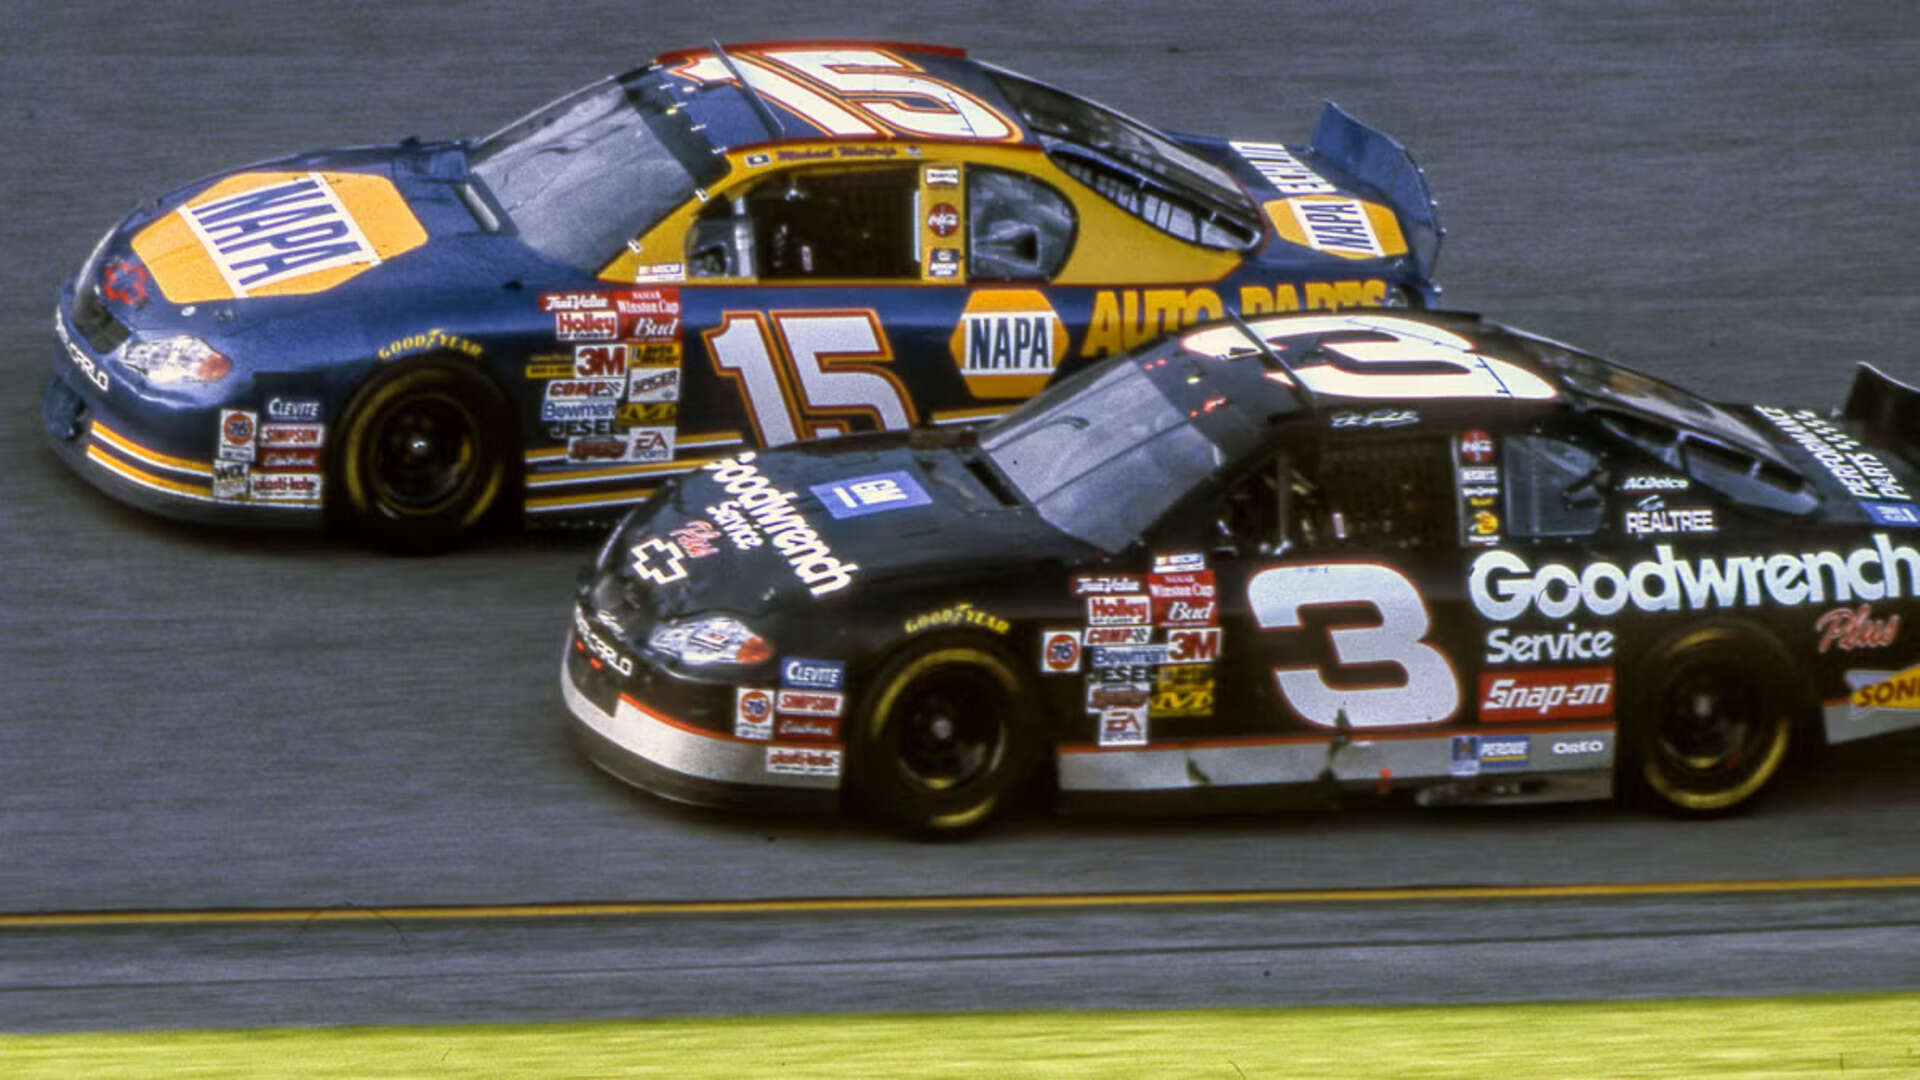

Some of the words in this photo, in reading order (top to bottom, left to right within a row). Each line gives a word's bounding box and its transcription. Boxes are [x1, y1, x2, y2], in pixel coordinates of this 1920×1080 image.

[667, 50, 1024, 141] 15
[190, 178, 363, 287] NAPA
[1300, 201, 1373, 250] NAPA
[617, 300, 657, 313] Winston
[658, 300, 679, 314] Cup
[559, 313, 616, 337] Holley
[634, 317, 679, 336] Bud
[970, 316, 1052, 370] NAPA
[577, 346, 626, 376] 3M
[1182, 316, 1558, 399] 3
[704, 308, 919, 448] 15
[268, 398, 320, 418] CLEVITE
[543, 400, 616, 419] Bowman
[229, 421, 250, 437] 76
[635, 431, 669, 450] EA
[1622, 476, 1689, 490] ACDelco
[1626, 509, 1714, 534] REALTREE
[1469, 533, 1920, 620] Goodwrench
[1168, 601, 1215, 621] Bud
[1816, 603, 1899, 653] Plus
[1051, 642, 1073, 660] 76
[1170, 630, 1218, 661] 3M
[1247, 562, 1459, 728] 3
[1485, 622, 1616, 665] Service
[1092, 647, 1167, 666] Bowman
[787, 661, 840, 682] CLEVITE
[1484, 678, 1611, 714] Snap-on
[1854, 676, 1920, 707] SON
[746, 700, 766, 715] 76
[1105, 712, 1142, 732] EA
[1553, 739, 1604, 754] OREO
